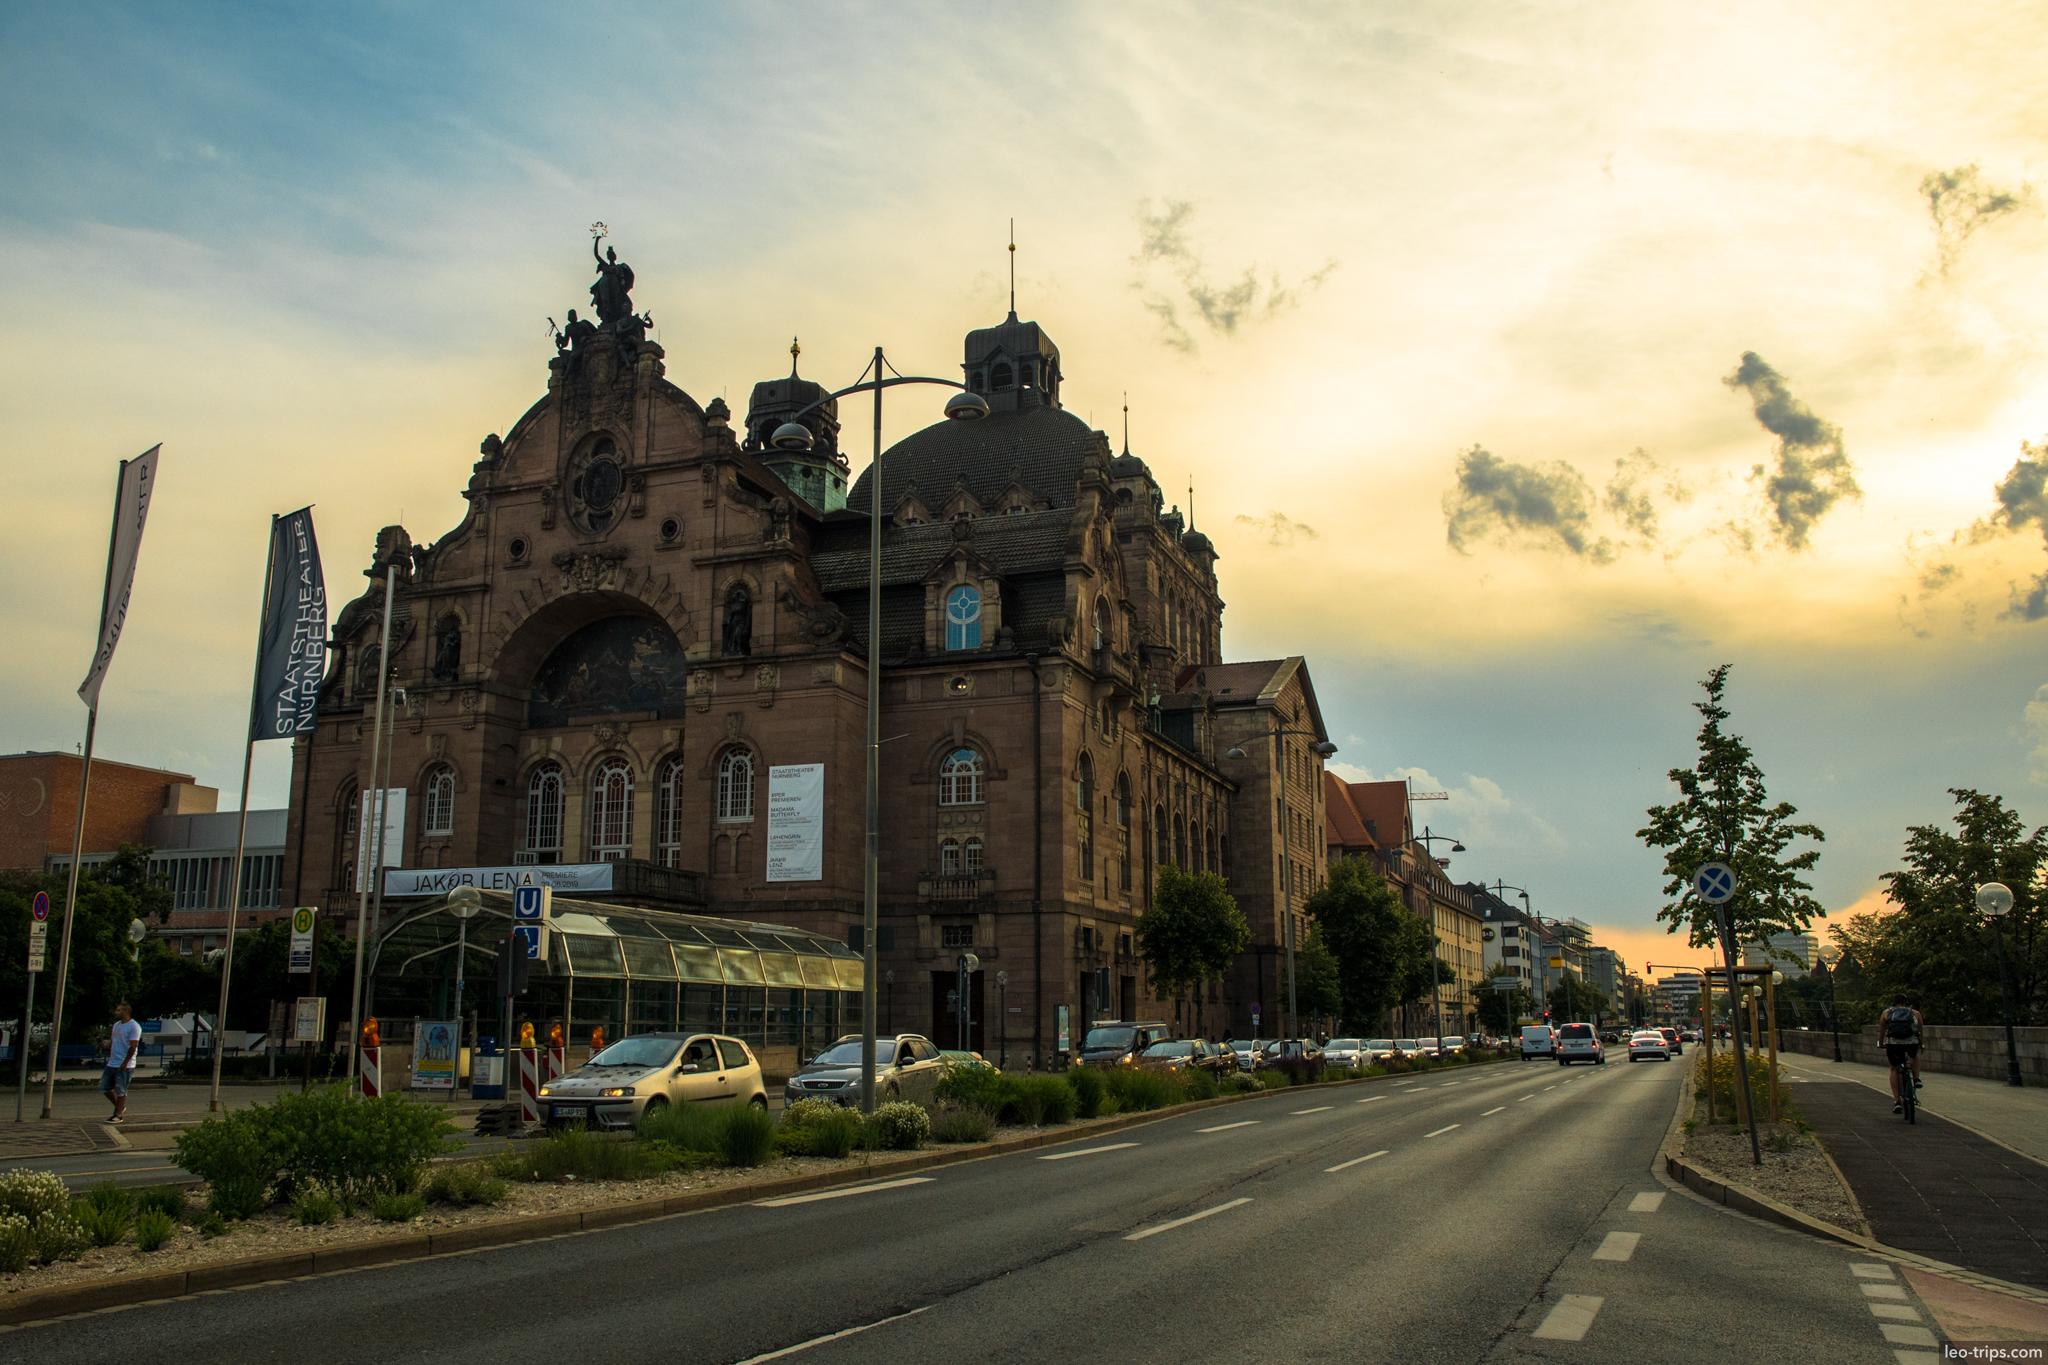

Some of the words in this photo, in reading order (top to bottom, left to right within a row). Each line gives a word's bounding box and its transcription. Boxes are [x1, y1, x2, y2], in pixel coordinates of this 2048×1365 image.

[276, 519, 312, 734] STAATSTHEATER
[295, 586, 325, 732] NÜRNBERG
[541, 871, 578, 879] PREMIERE
[519, 890, 538, 915] U
[298, 914, 308, 928] H
